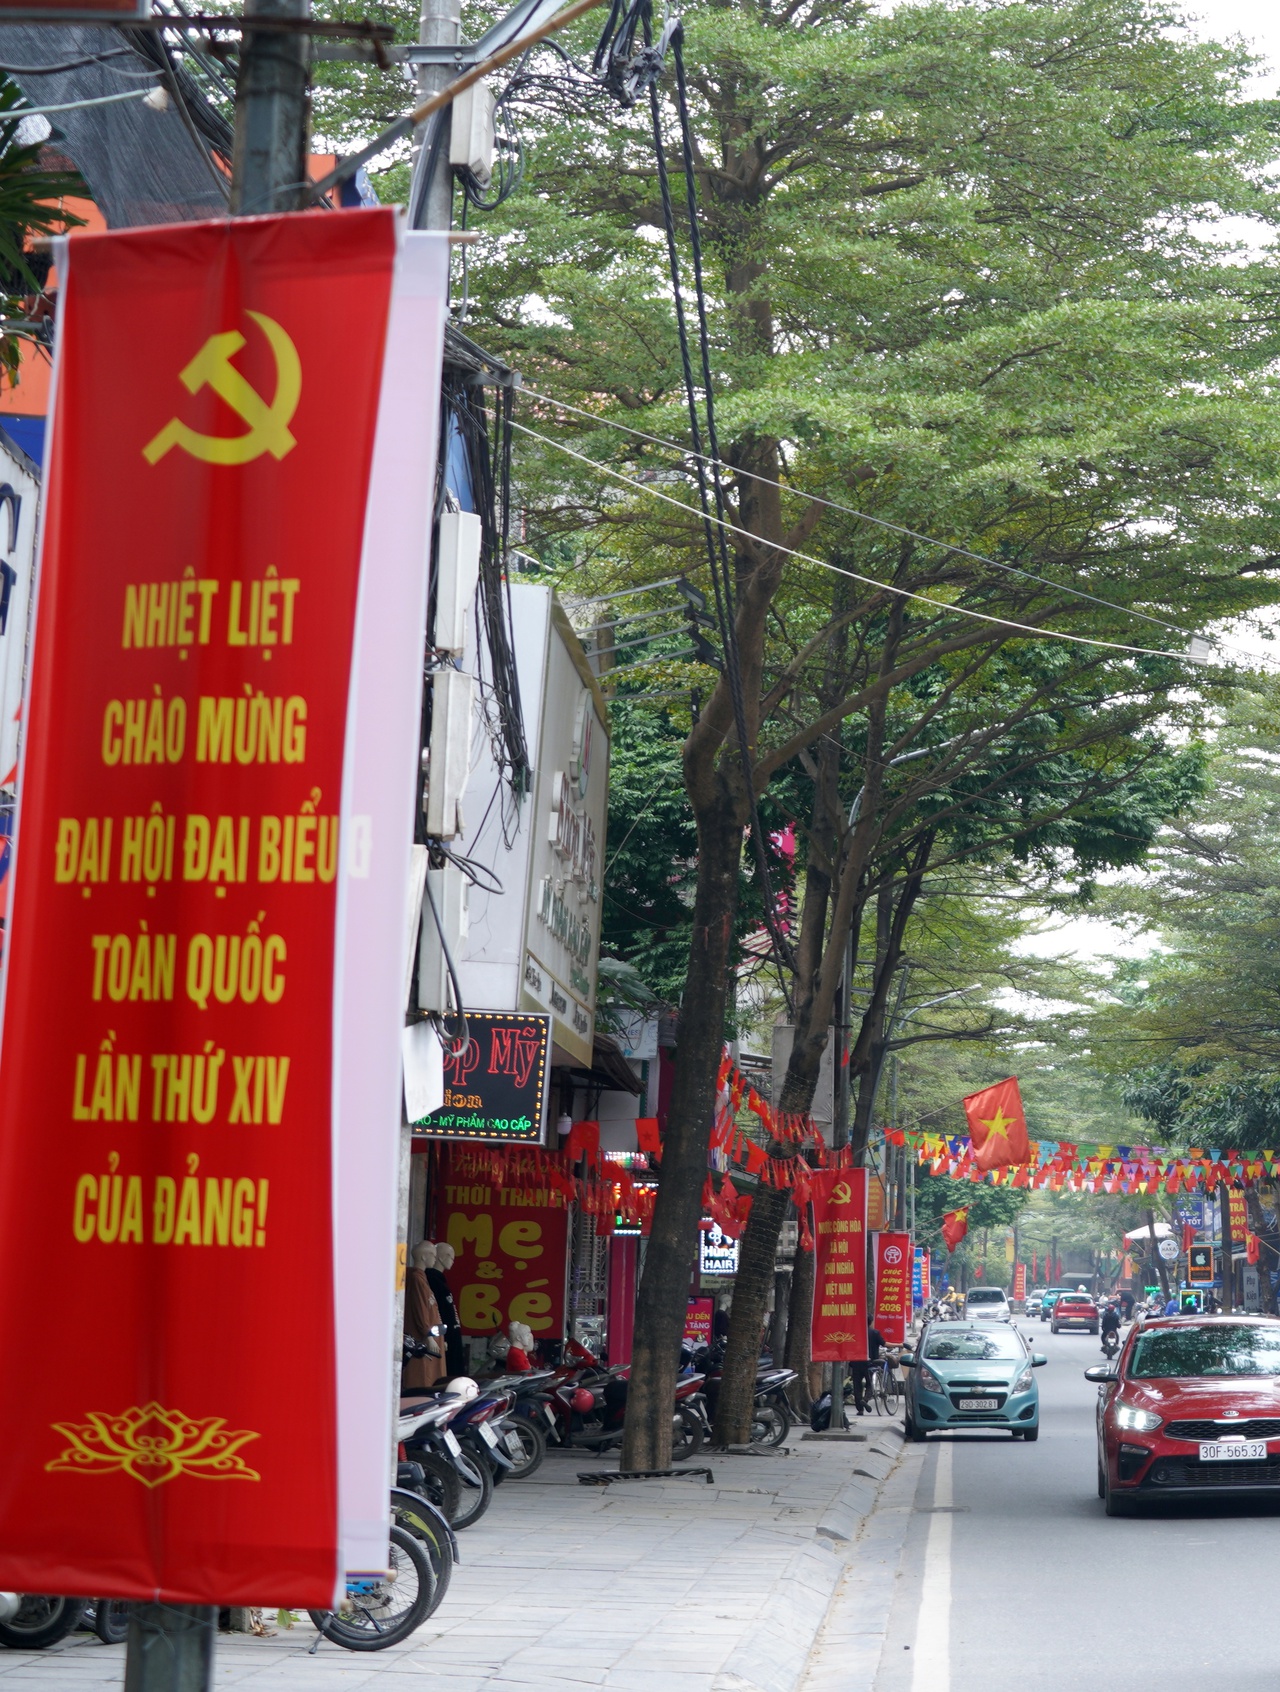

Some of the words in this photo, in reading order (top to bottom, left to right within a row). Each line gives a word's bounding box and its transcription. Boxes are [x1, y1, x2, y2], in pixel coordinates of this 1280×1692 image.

[122, 564, 219, 661] NHIỆT
[227, 564, 300, 661] LIỆT
[102, 684, 187, 766] CHÀO
[196, 683, 308, 765] MỪNG
[55, 817, 113, 898] ĐẠI
[120, 801, 175, 898] HỘI
[183, 814, 249, 898] ĐẠI
[258, 787, 340, 883] BIỂU
[92, 920, 176, 1001] TOÀN
[186, 911, 287, 1009] QUỐC
[443, 1037, 480, 1086] op
[488, 1027, 540, 1088] Mỹ
[73, 1030, 141, 1122] LẦN
[151, 1040, 225, 1124] THỨ
[228, 1055, 290, 1125] XIV
[439, 1114, 455, 1126] MỸ
[456, 1112, 485, 1129] PHẨM
[486, 1118, 508, 1130] CAO
[510, 1115, 532, 1131] CẤP
[73, 1151, 143, 1244] CỦA
[153, 1153, 269, 1247] ĐẢNG!
[445, 1182, 492, 1206] THỜI
[447, 1212, 544, 1270] Mẹ
[833, 1220, 849, 1235] CỘNG
[849, 1219, 862, 1233] HÒA
[475, 1261, 503, 1279] &
[704, 1245, 735, 1260] Hùng
[705, 1260, 734, 1269] HAIR
[459, 1278, 554, 1331] Bé
[825, 1282, 839, 1297] VIỆT
[839, 1283, 853, 1295] NAM
[879, 1303, 902, 1312] 2026
[1202, 1444, 1265, 1459] 30F-565.32
